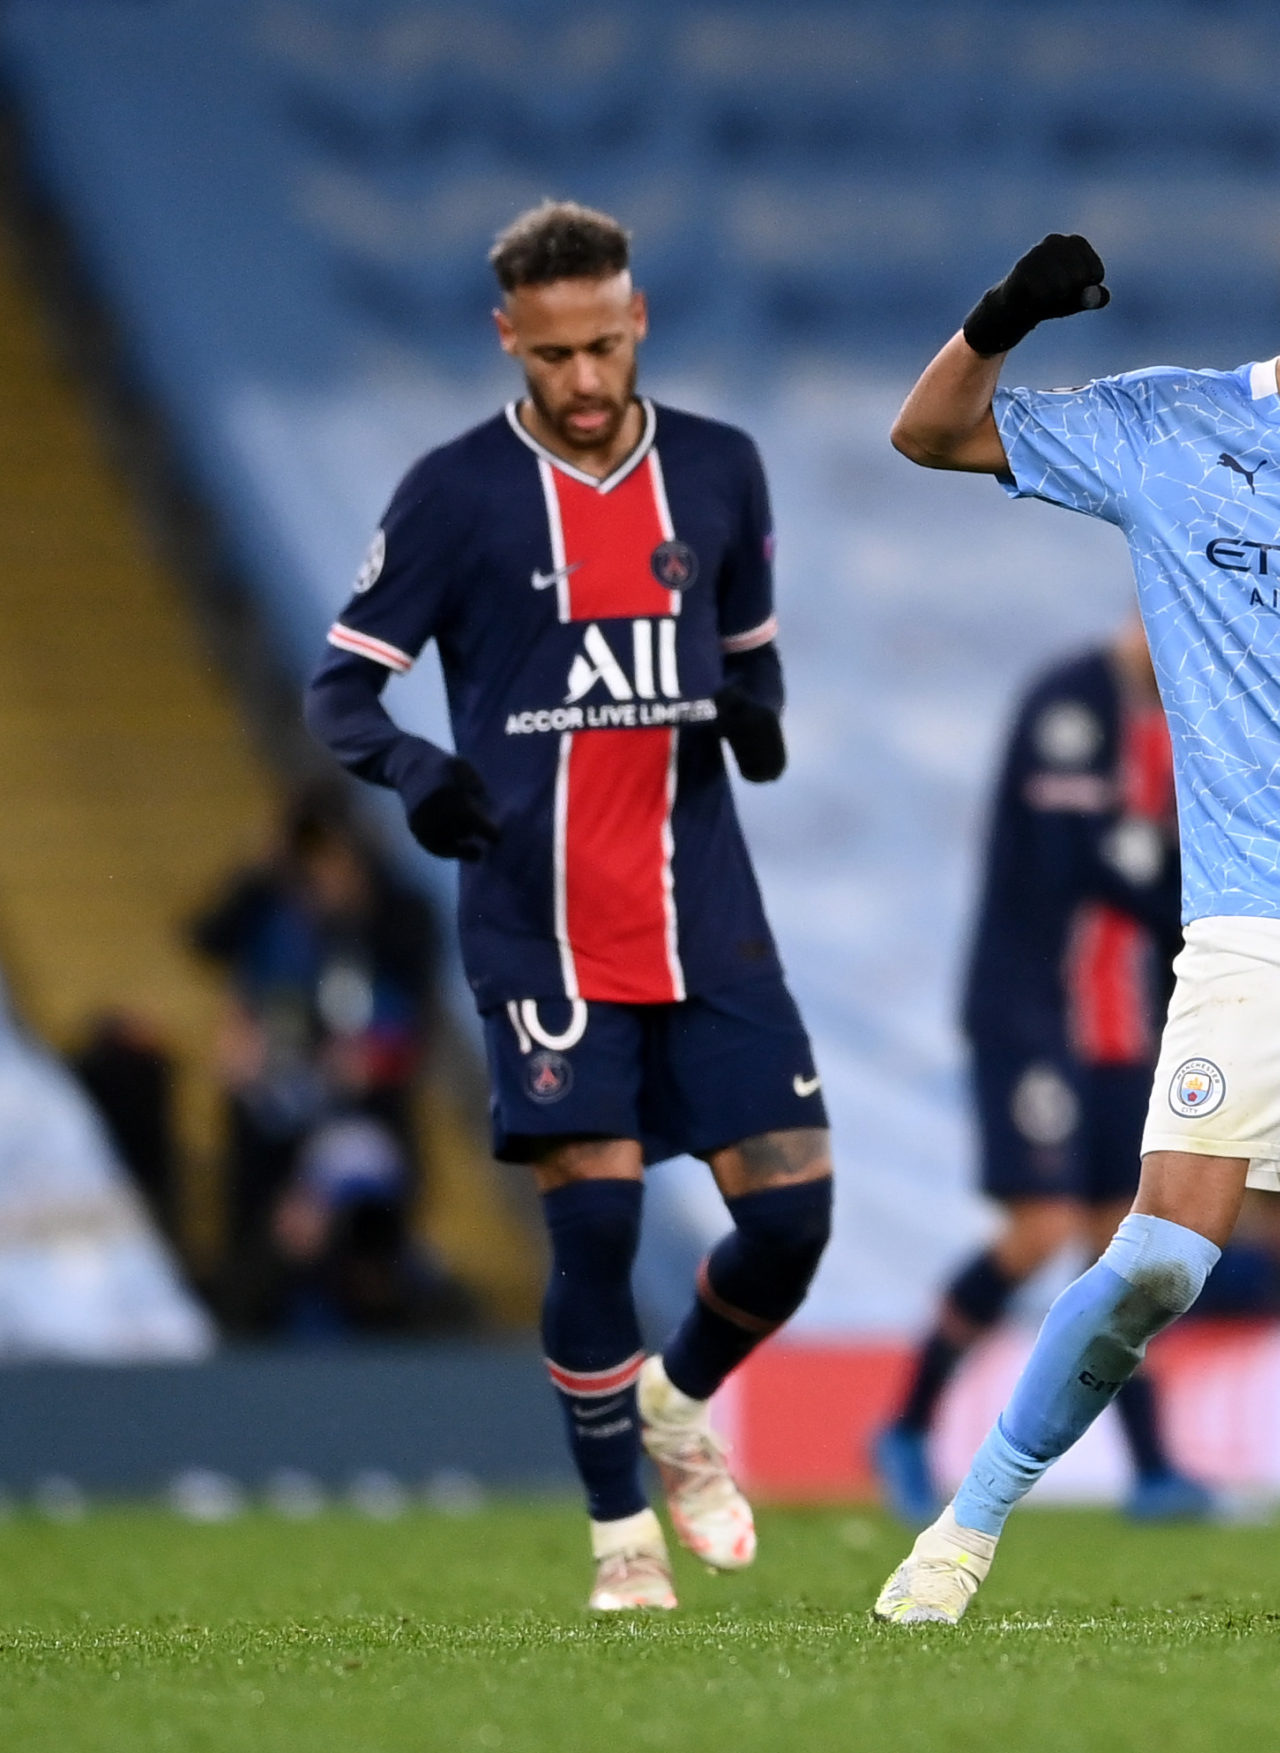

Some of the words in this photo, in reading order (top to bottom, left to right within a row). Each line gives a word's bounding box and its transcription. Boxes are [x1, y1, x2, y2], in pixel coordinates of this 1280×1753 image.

[505, 706, 585, 736] ACCOR
[587, 703, 637, 728] LIVE
[1177, 1062, 1220, 1084] MANCHESTER
[1181, 1106, 1199, 1114] CITY
